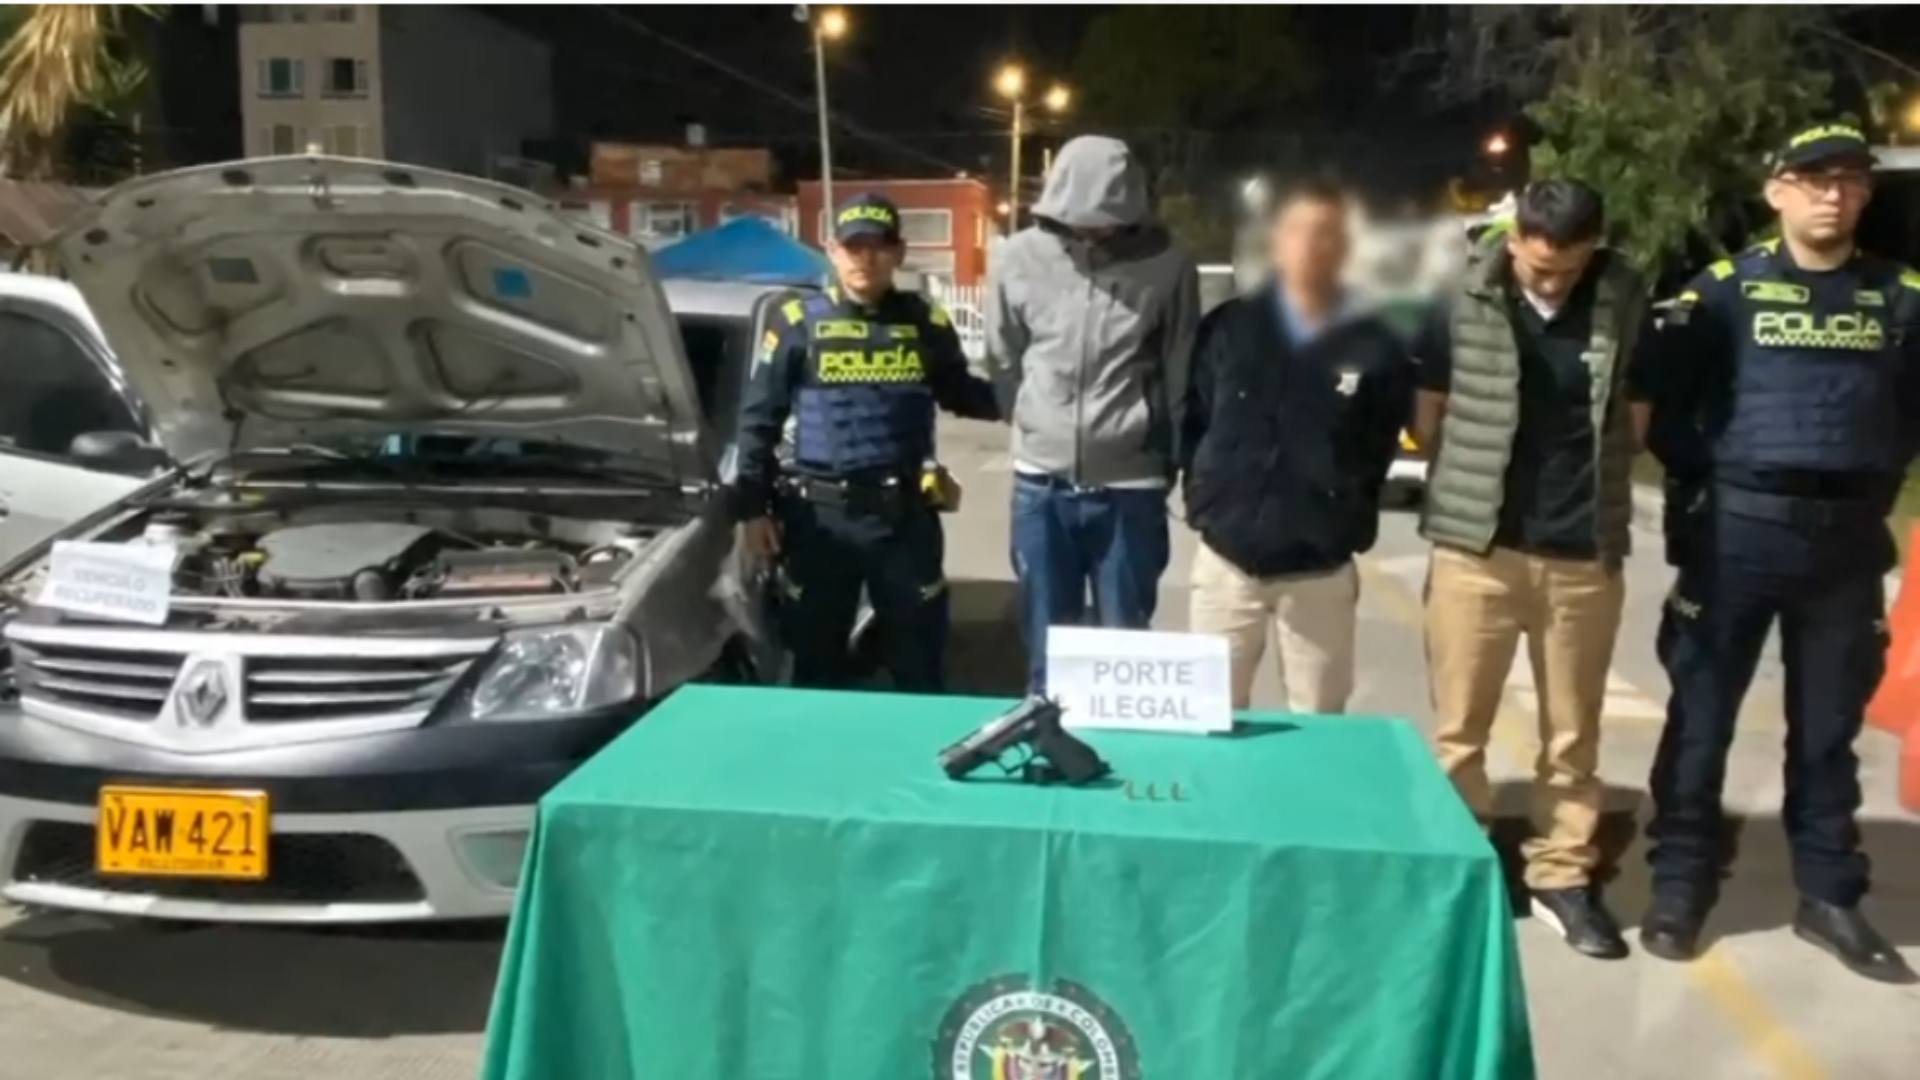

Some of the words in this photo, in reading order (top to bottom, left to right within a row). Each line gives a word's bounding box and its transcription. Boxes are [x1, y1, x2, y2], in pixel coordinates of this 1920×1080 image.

[819, 343, 922, 371] POLICÍA
[1093, 660, 1194, 686] PORTE
[1090, 694, 1198, 720] ILEGAL
[106, 807, 175, 854] VAW
[187, 810, 256, 856] 421
